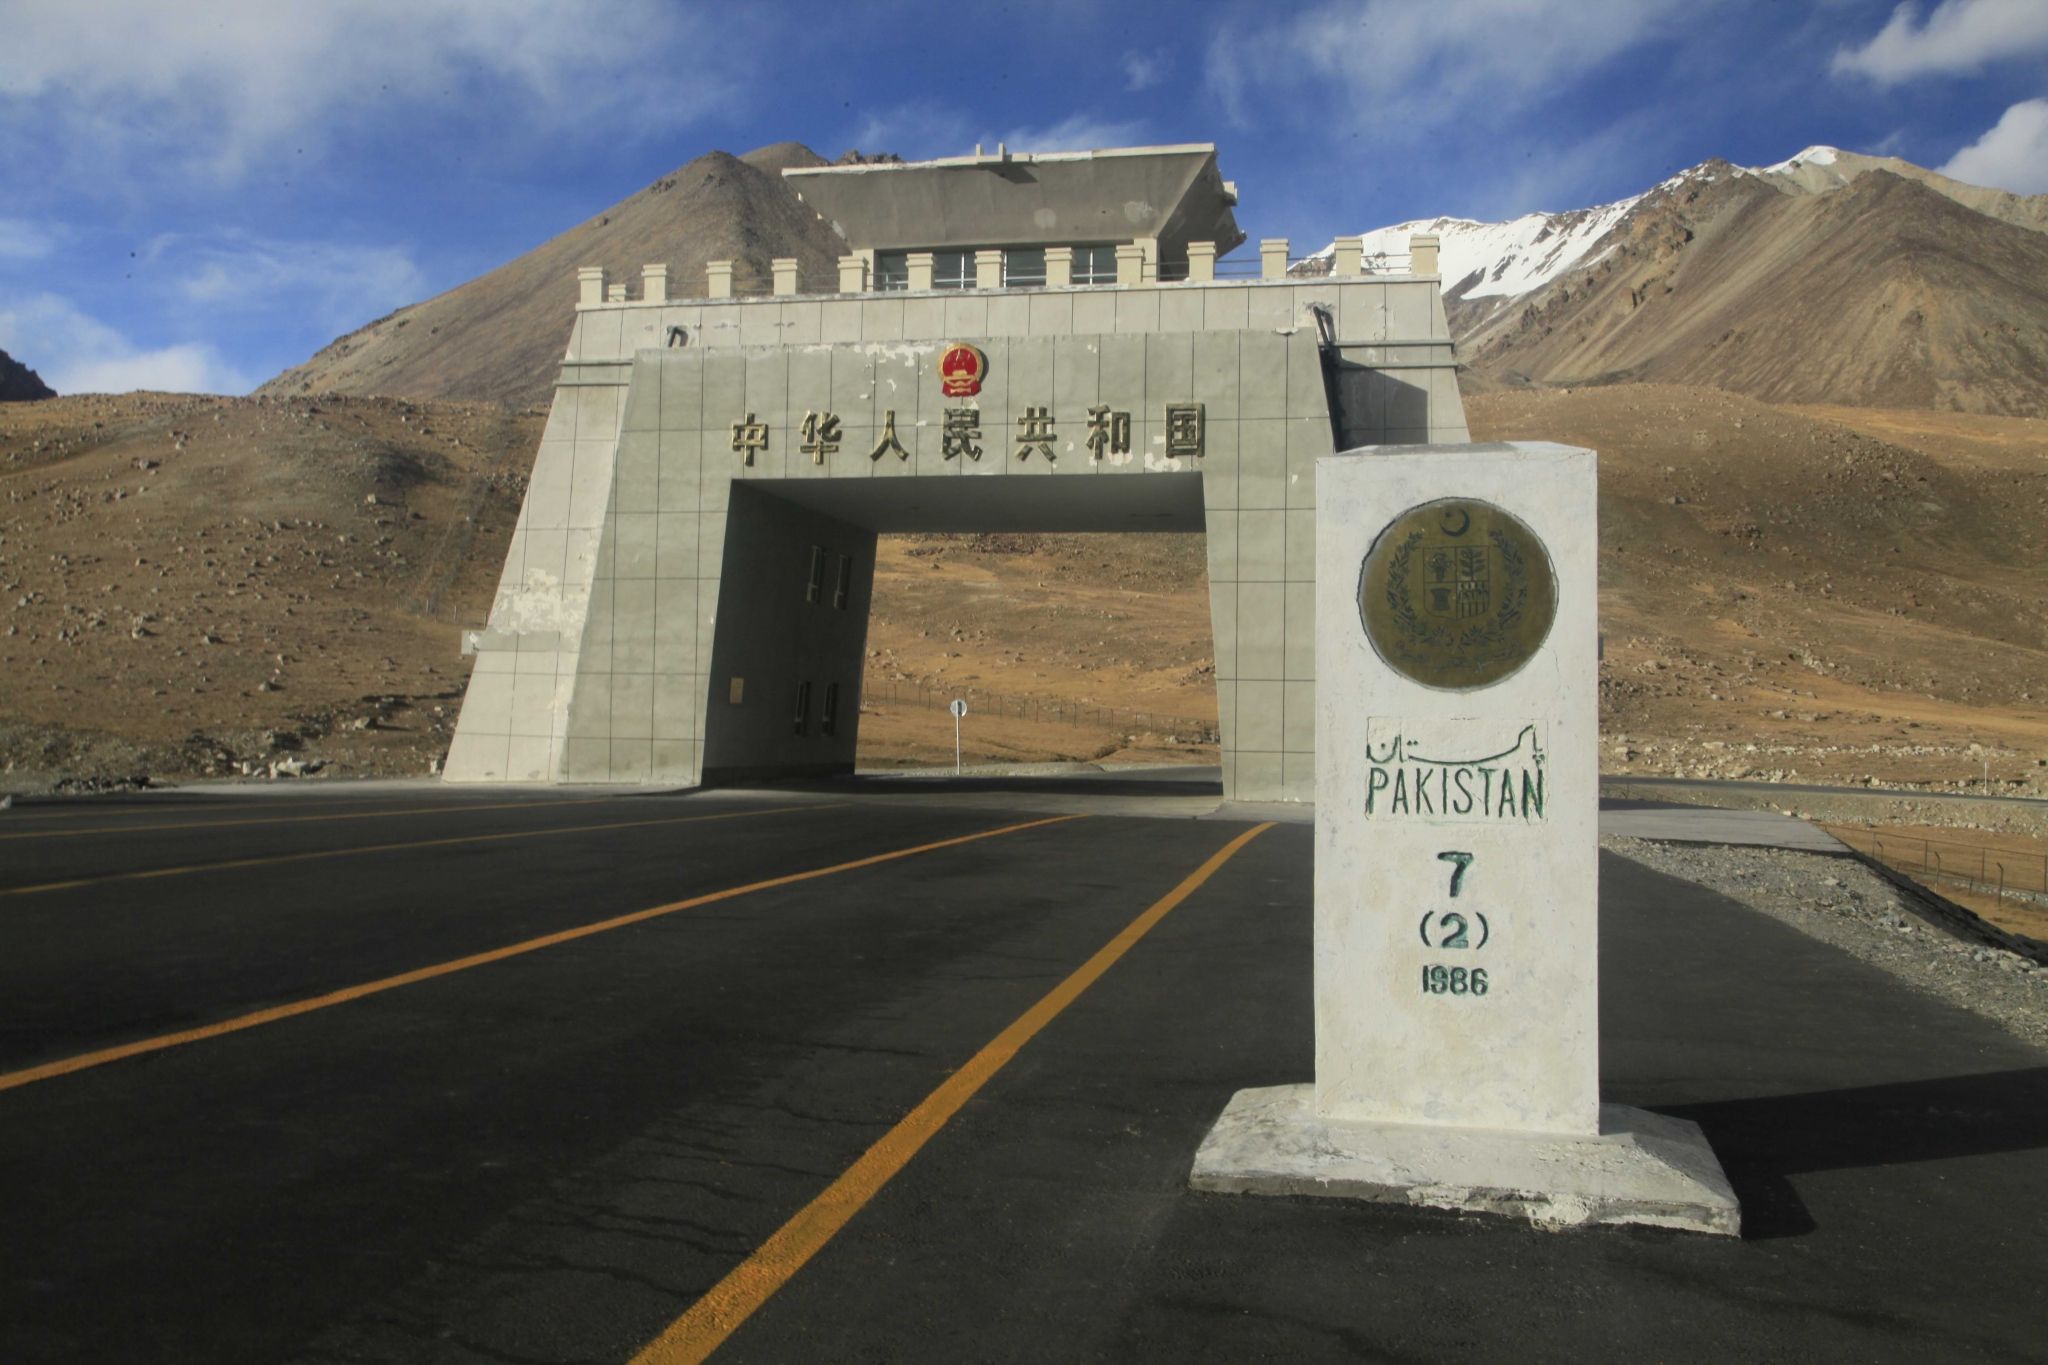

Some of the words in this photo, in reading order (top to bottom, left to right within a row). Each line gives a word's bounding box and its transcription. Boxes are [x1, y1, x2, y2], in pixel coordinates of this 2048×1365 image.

[731, 402, 1206, 467] 中华人民共和国
[1366, 767, 1544, 818] PAKISTAN
[1437, 851, 1474, 897] 7
[1420, 910, 1489, 949] (2)
[1423, 965, 1489, 996] 1986
